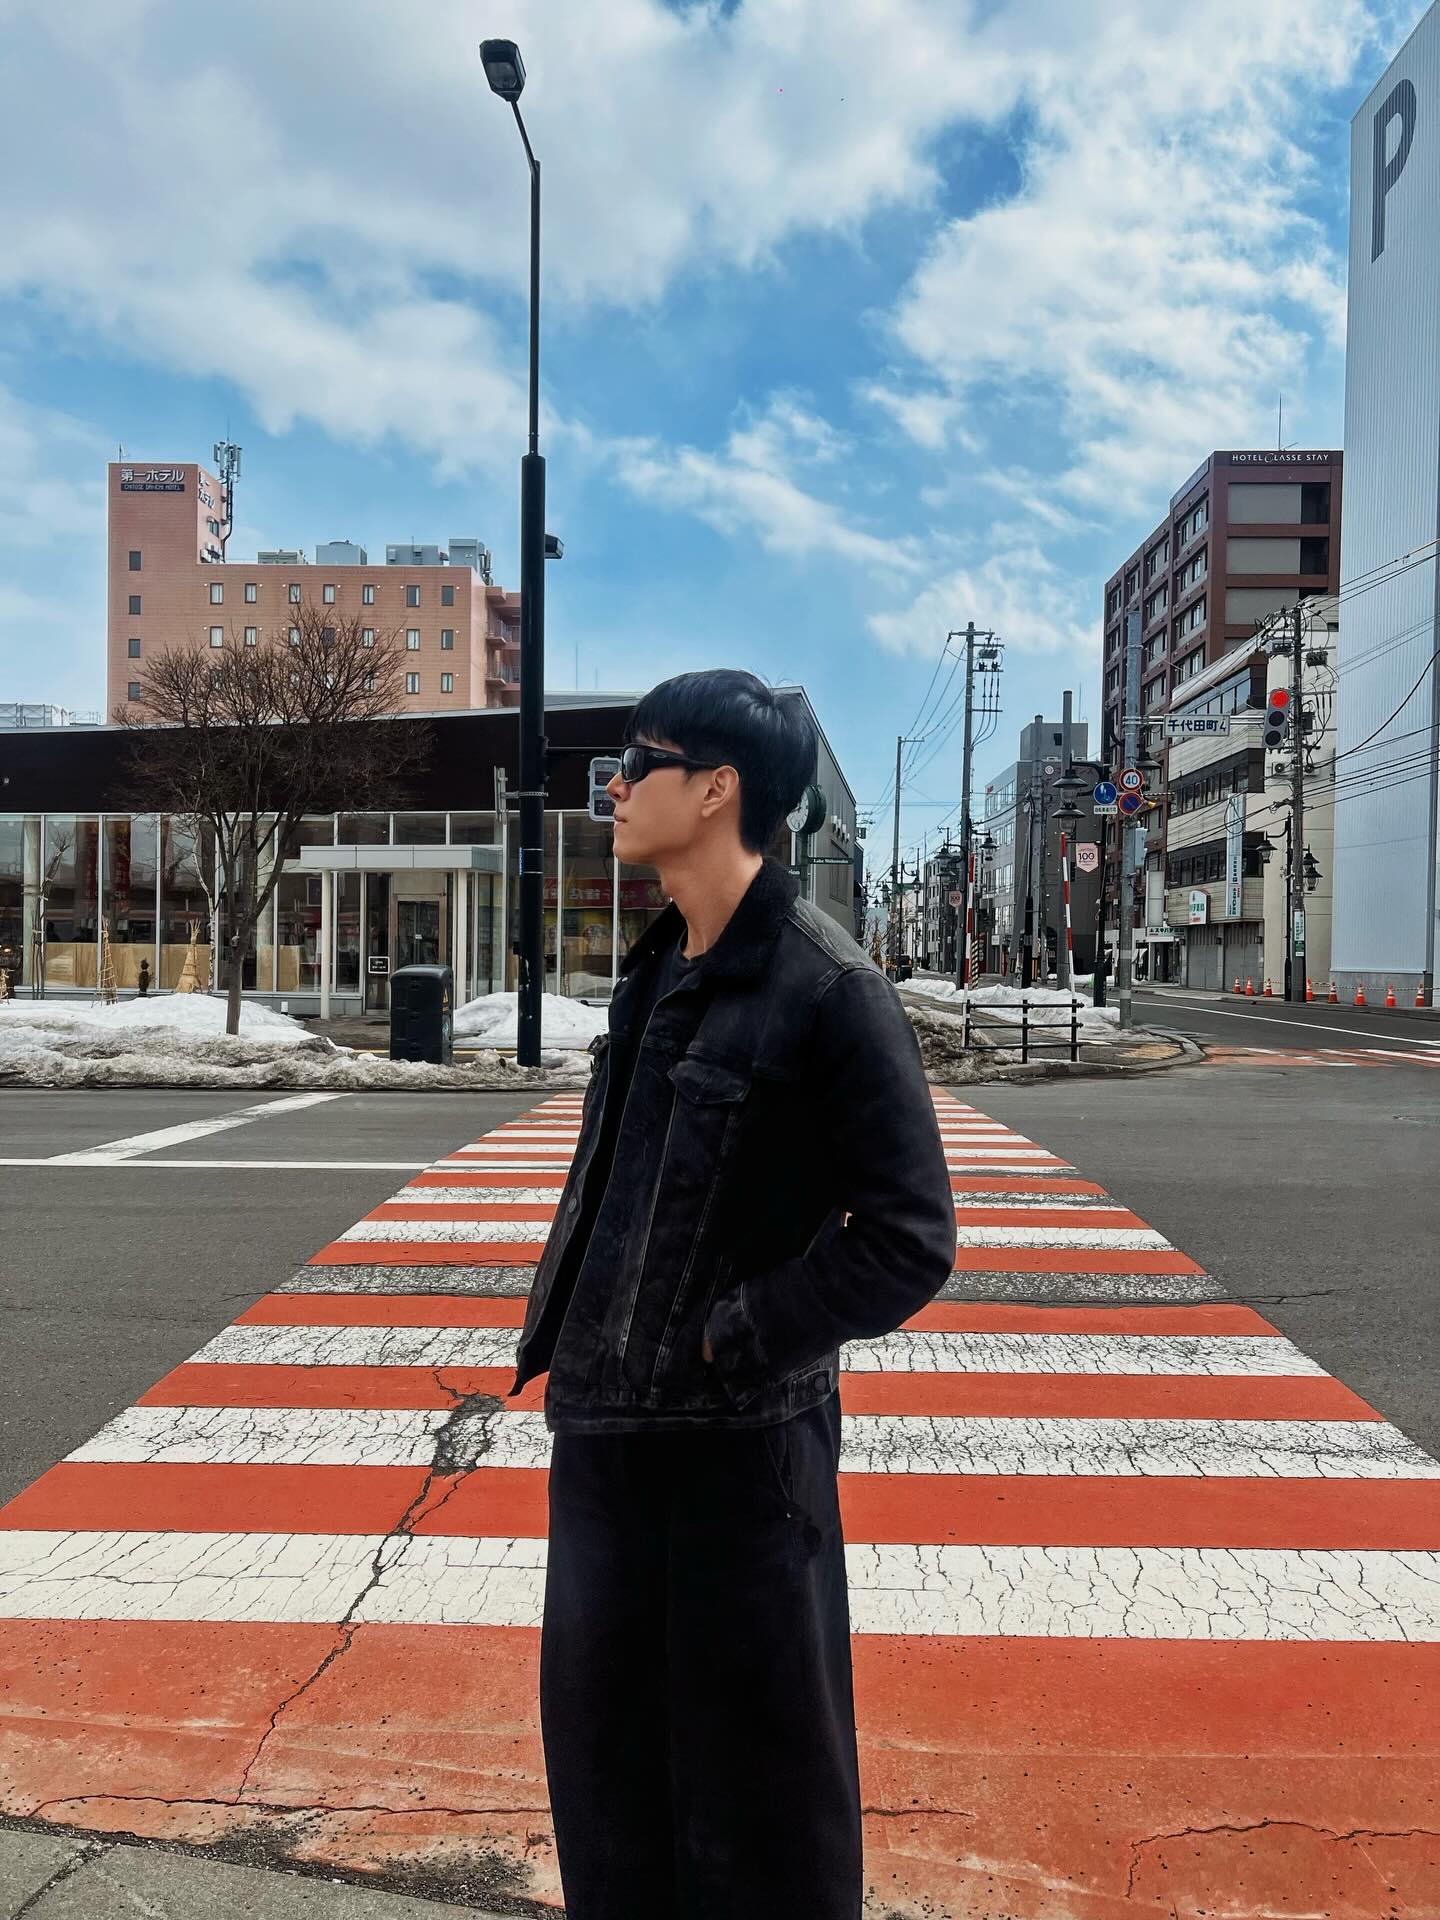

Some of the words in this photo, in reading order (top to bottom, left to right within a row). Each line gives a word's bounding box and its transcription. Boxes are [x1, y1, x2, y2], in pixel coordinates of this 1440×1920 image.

[1371, 79, 1417, 264] P
[1232, 454, 1263, 462] HOTEL
[1264, 452, 1302, 464] CLASSE
[121, 468, 185, 482] 第一ホテル
[1125, 775, 1138, 786] 40
[1078, 852, 1095, 860] 100
